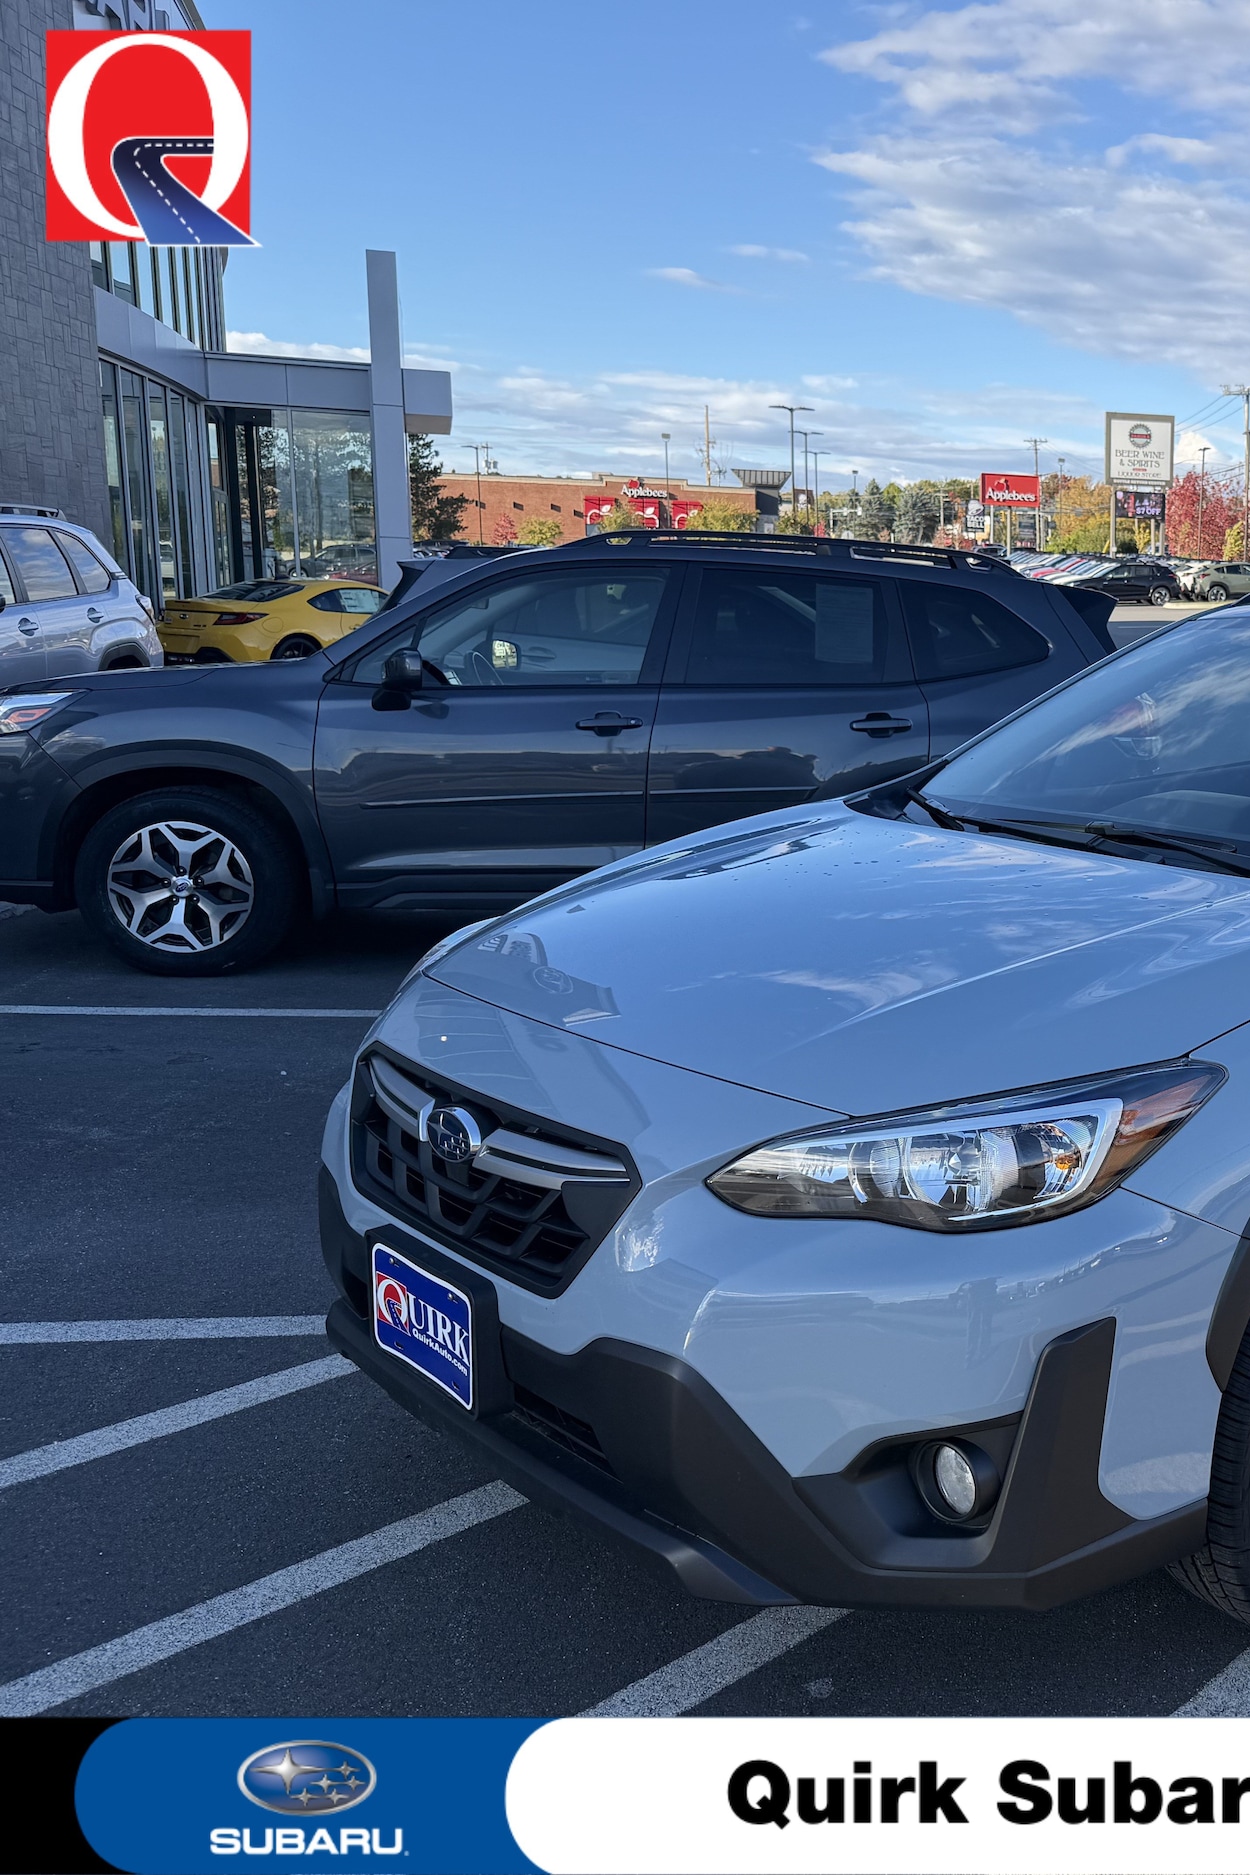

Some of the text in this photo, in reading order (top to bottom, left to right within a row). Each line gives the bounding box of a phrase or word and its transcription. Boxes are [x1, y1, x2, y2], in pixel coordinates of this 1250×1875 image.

[1115, 449, 1165, 460] BEER WINE
[1119, 458, 1161, 468] & SPIRITS
[1146, 507, 1162, 516] OFF
[376, 1277, 470, 1367] QUIRK
[412, 1328, 468, 1377] QuirkAuto.com
